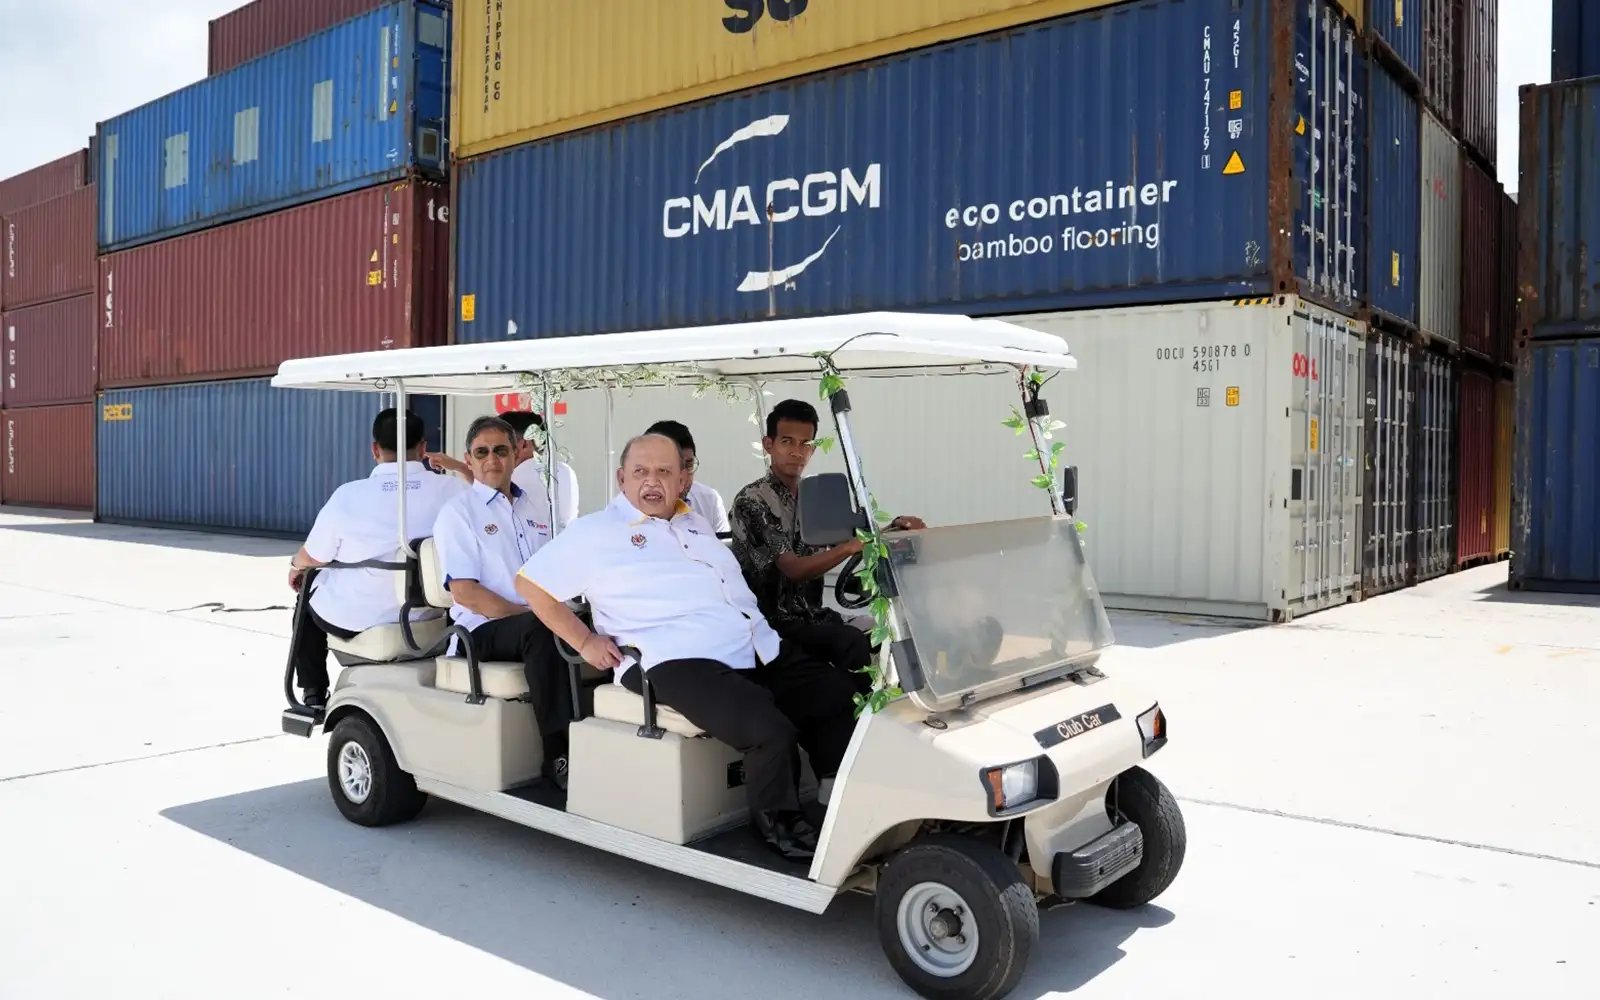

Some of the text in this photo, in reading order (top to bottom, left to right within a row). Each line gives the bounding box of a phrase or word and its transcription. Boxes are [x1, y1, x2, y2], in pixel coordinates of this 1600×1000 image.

[1232, 19, 1240, 69] 45G1
[493, 81, 501, 100] CO
[945, 180, 1178, 229] eco container
[1061, 221, 1160, 252] flooring
[1192, 345, 1237, 359] 590878
[1192, 359, 1220, 373] 45G1
[1056, 713, 1103, 739] Club Car
